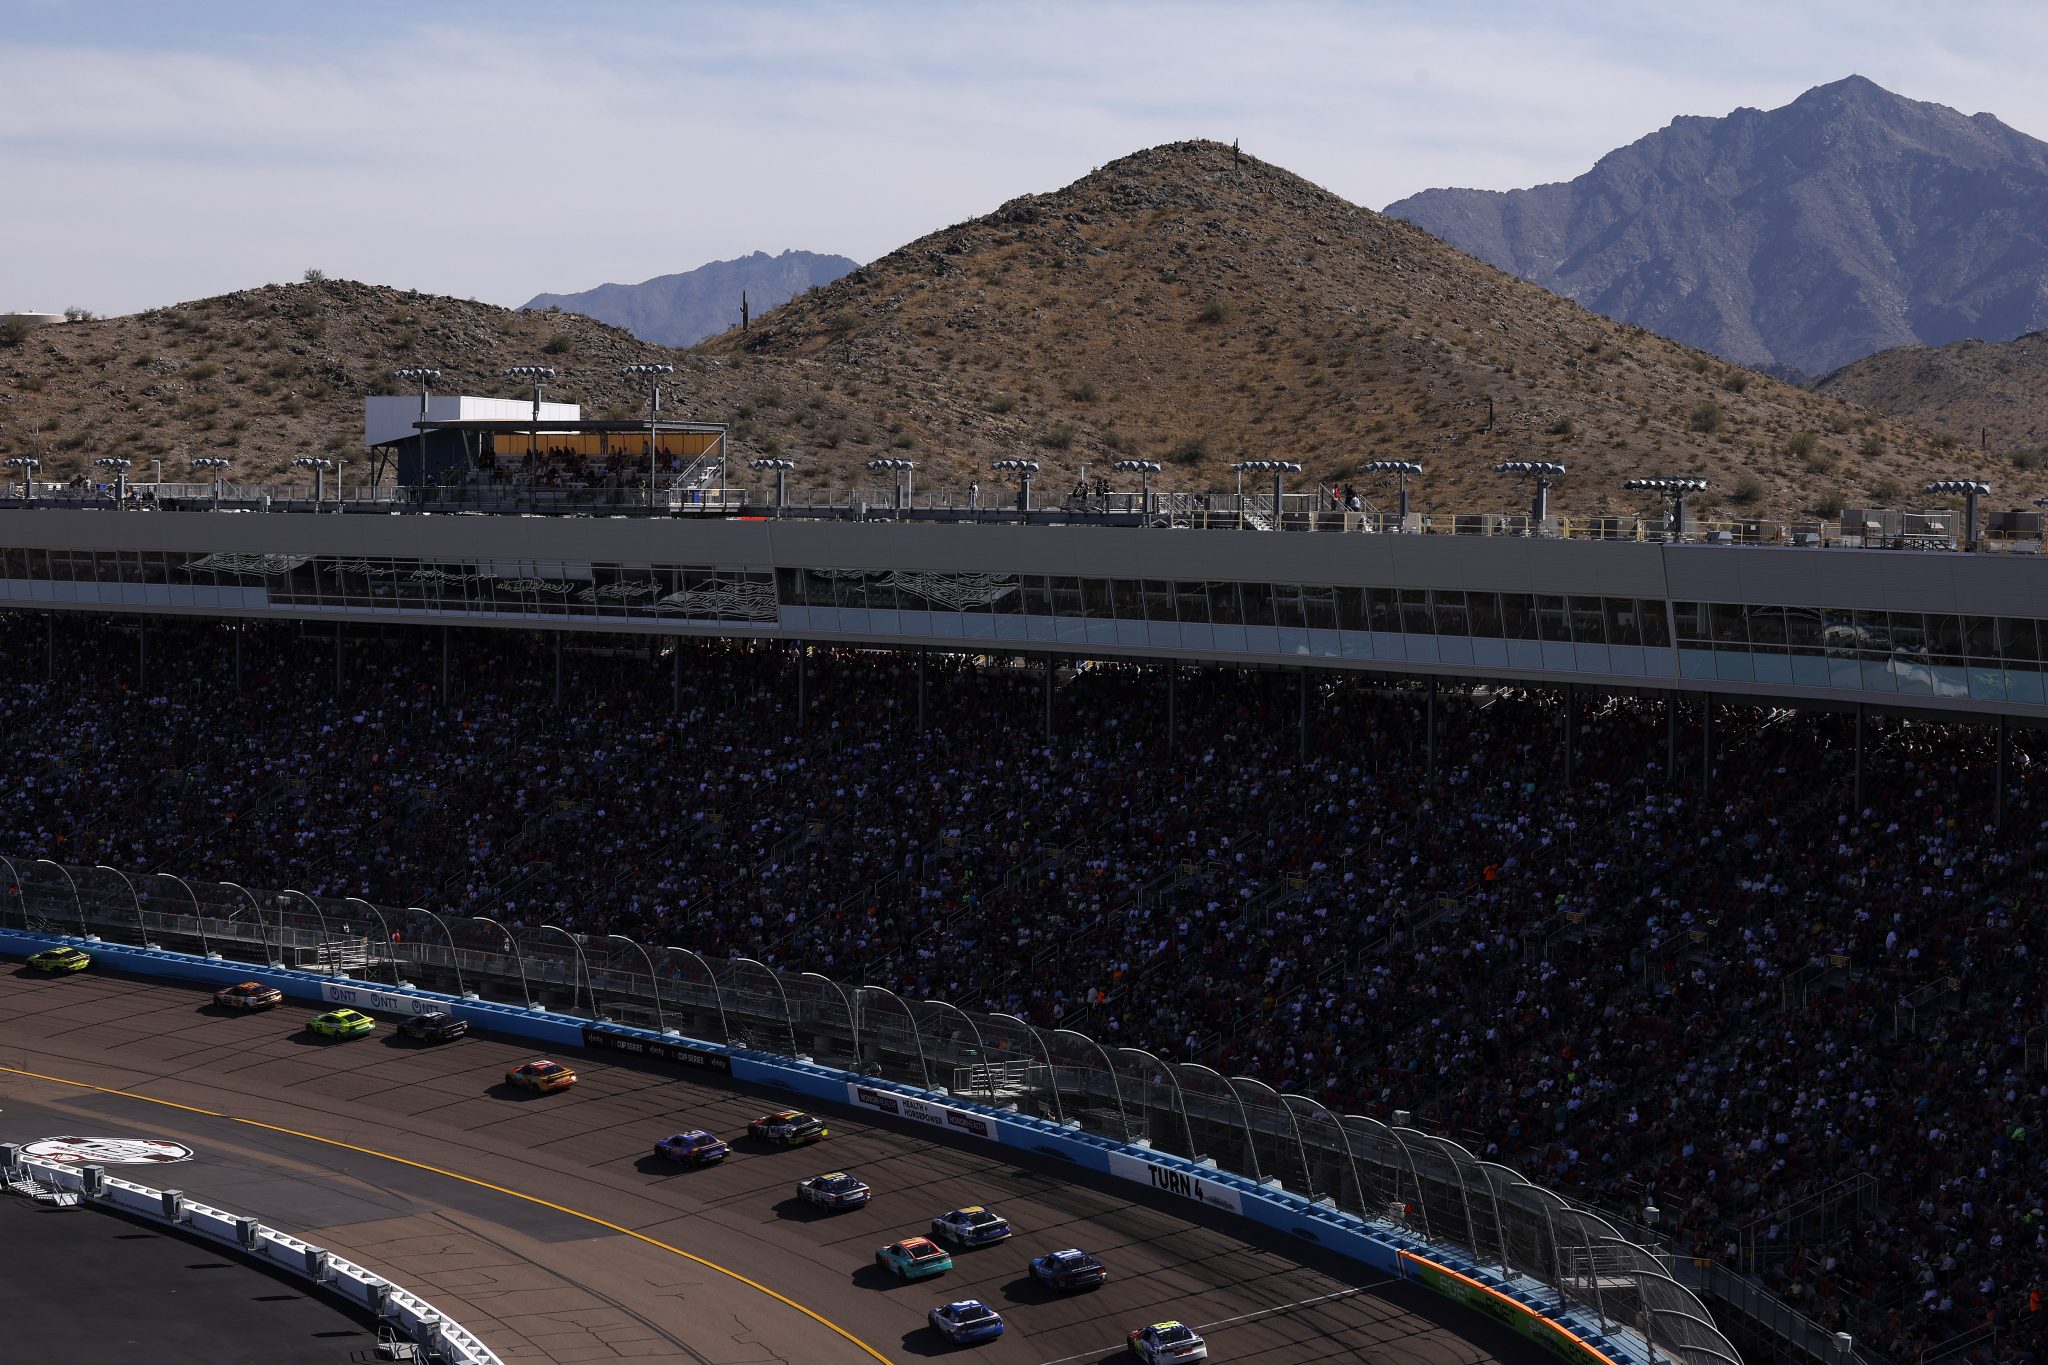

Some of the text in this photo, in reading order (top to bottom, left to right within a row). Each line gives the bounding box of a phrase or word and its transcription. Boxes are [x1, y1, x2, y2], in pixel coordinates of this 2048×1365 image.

[339, 989, 357, 1002] NTT
[380, 996, 398, 1008] NTT
[421, 1003, 439, 1014] NTT
[626, 1042, 643, 1053] SERIES
[678, 1052, 704, 1065] CUP SERIES
[860, 1094, 897, 1109] HONORHEALTH
[902, 1100, 924, 1112] HEALTH
[904, 1108, 943, 1126] HORSEPOWER
[950, 1116, 986, 1131] HONORHEALTH
[1148, 1164, 1203, 1201] TURN 4
[1439, 1276, 1472, 1302] POET
[1485, 1297, 1516, 1327] POET
